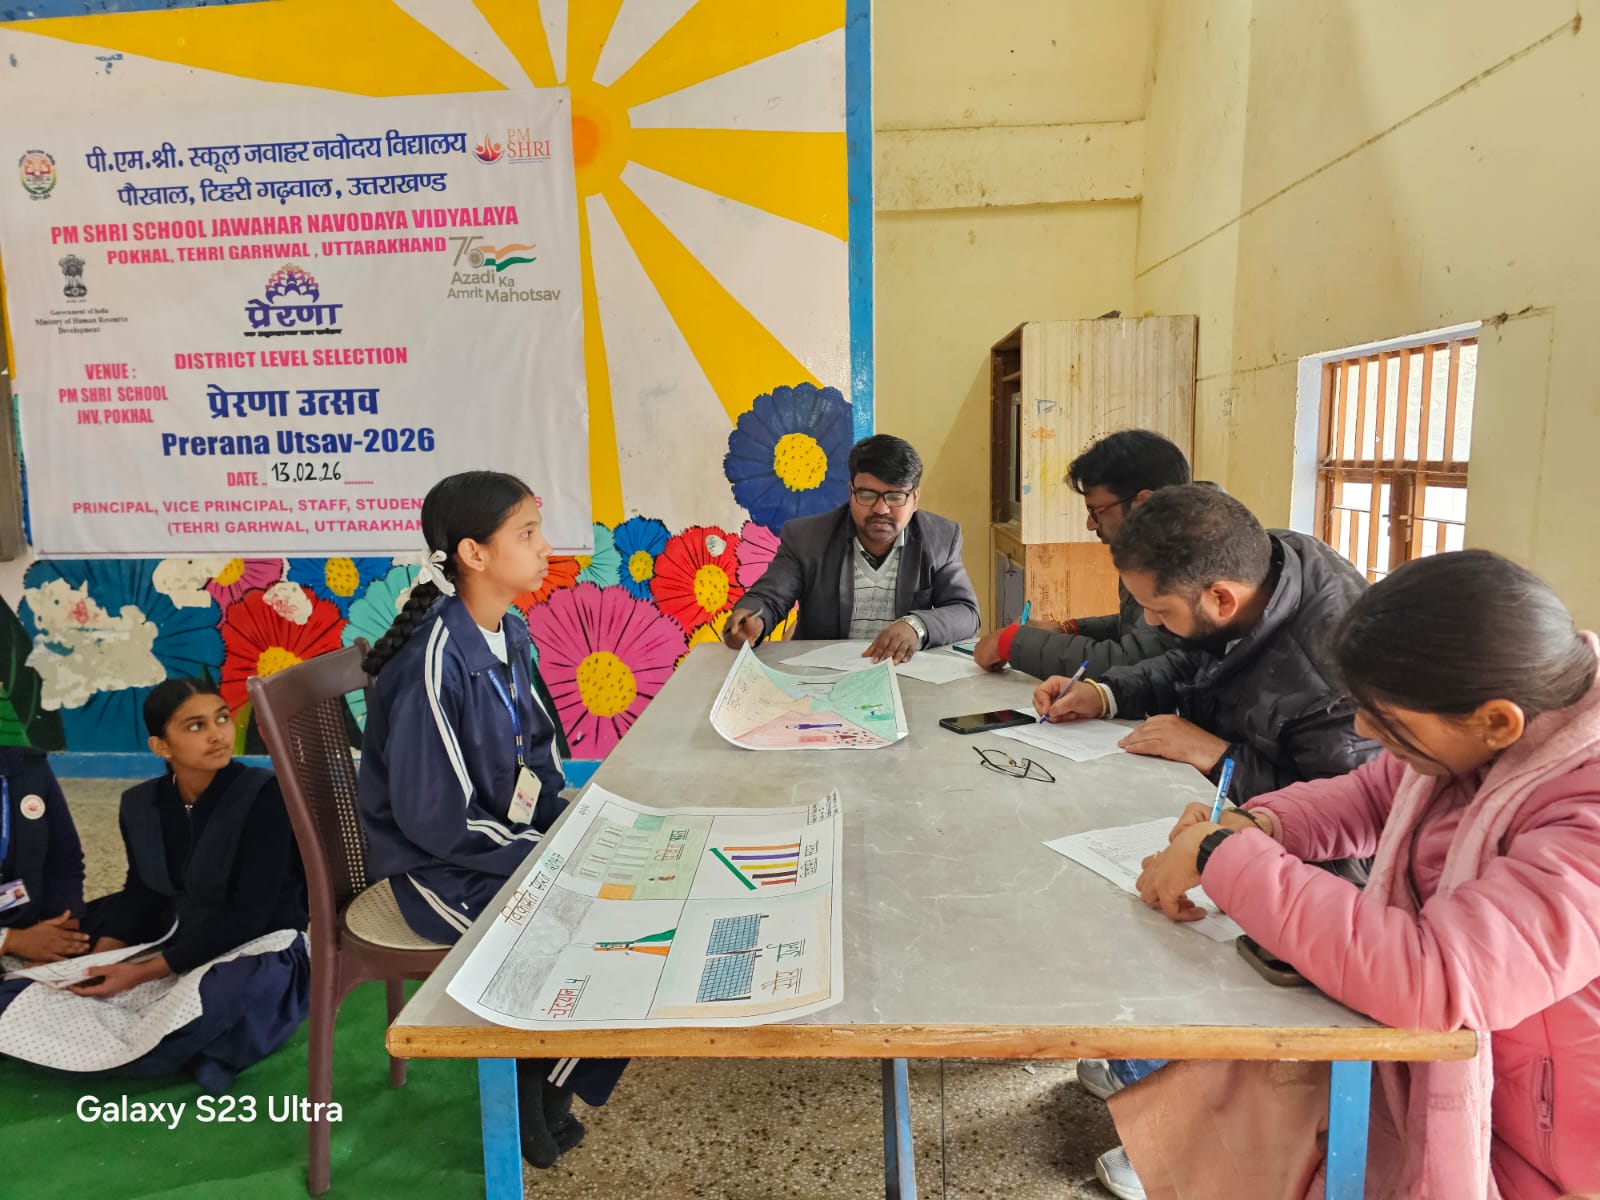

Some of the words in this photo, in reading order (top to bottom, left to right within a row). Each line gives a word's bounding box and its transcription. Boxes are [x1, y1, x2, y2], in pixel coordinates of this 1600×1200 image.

[506, 126, 531, 141] PM
[85, 142, 184, 172] पी.एम.श्री.
[187, 145, 241, 174] स्कूल
[243, 141, 310, 164] जवाहर
[312, 133, 382, 160] नवोदय
[386, 129, 467, 157] विद्यालय
[506, 140, 552, 159] SHRI
[117, 182, 195, 206] पौखाल,
[200, 176, 252, 202] टिहरी
[347, 173, 448, 196] उत्तराखण्ड
[51, 225, 79, 245] PM
[83, 223, 128, 243] SHRI
[132, 219, 207, 241] SCHOOL
[211, 215, 303, 238] JAWAHAR
[306, 209, 408, 234] NAVODAYA
[411, 205, 519, 229] VIDYALAYA
[176, 245, 225, 262] TEHRI
[228, 242, 310, 261] GARHWAL
[321, 236, 447, 257] UTTARAKHAND
[451, 270, 495, 285] Azadi
[499, 276, 515, 288] Ka
[447, 287, 484, 299] Amrit
[485, 289, 561, 303] Mahotsav
[244, 298, 343, 329] प्रेरणा
[174, 351, 256, 370] DISTRICT
[260, 349, 309, 368] LEVEL
[312, 347, 408, 366] SELECTION
[85, 363, 128, 381] VENUE
[58, 388, 78, 403] PM
[81, 387, 111, 402] SHRI
[117, 386, 168, 402] SCHOOL
[206, 383, 290, 419] प्रेरणा
[296, 388, 380, 416] उत्सव
[104, 408, 153, 424] POKHAL
[161, 433, 271, 457] Prerana
[277, 427, 435, 454] Utsav-2026
[226, 471, 259, 487] DATE
[271, 461, 342, 483] 13.02.26
[72, 501, 159, 516] PRINCIPAL,
[162, 500, 200, 513] VICE
[203, 499, 294, 514] PRINCIPAL,
[298, 498, 351, 513] STAFF,
[355, 497, 424, 511] STUDEN
[167, 520, 220, 537] (TEHRI
[224, 520, 310, 535] GARHWAL,
